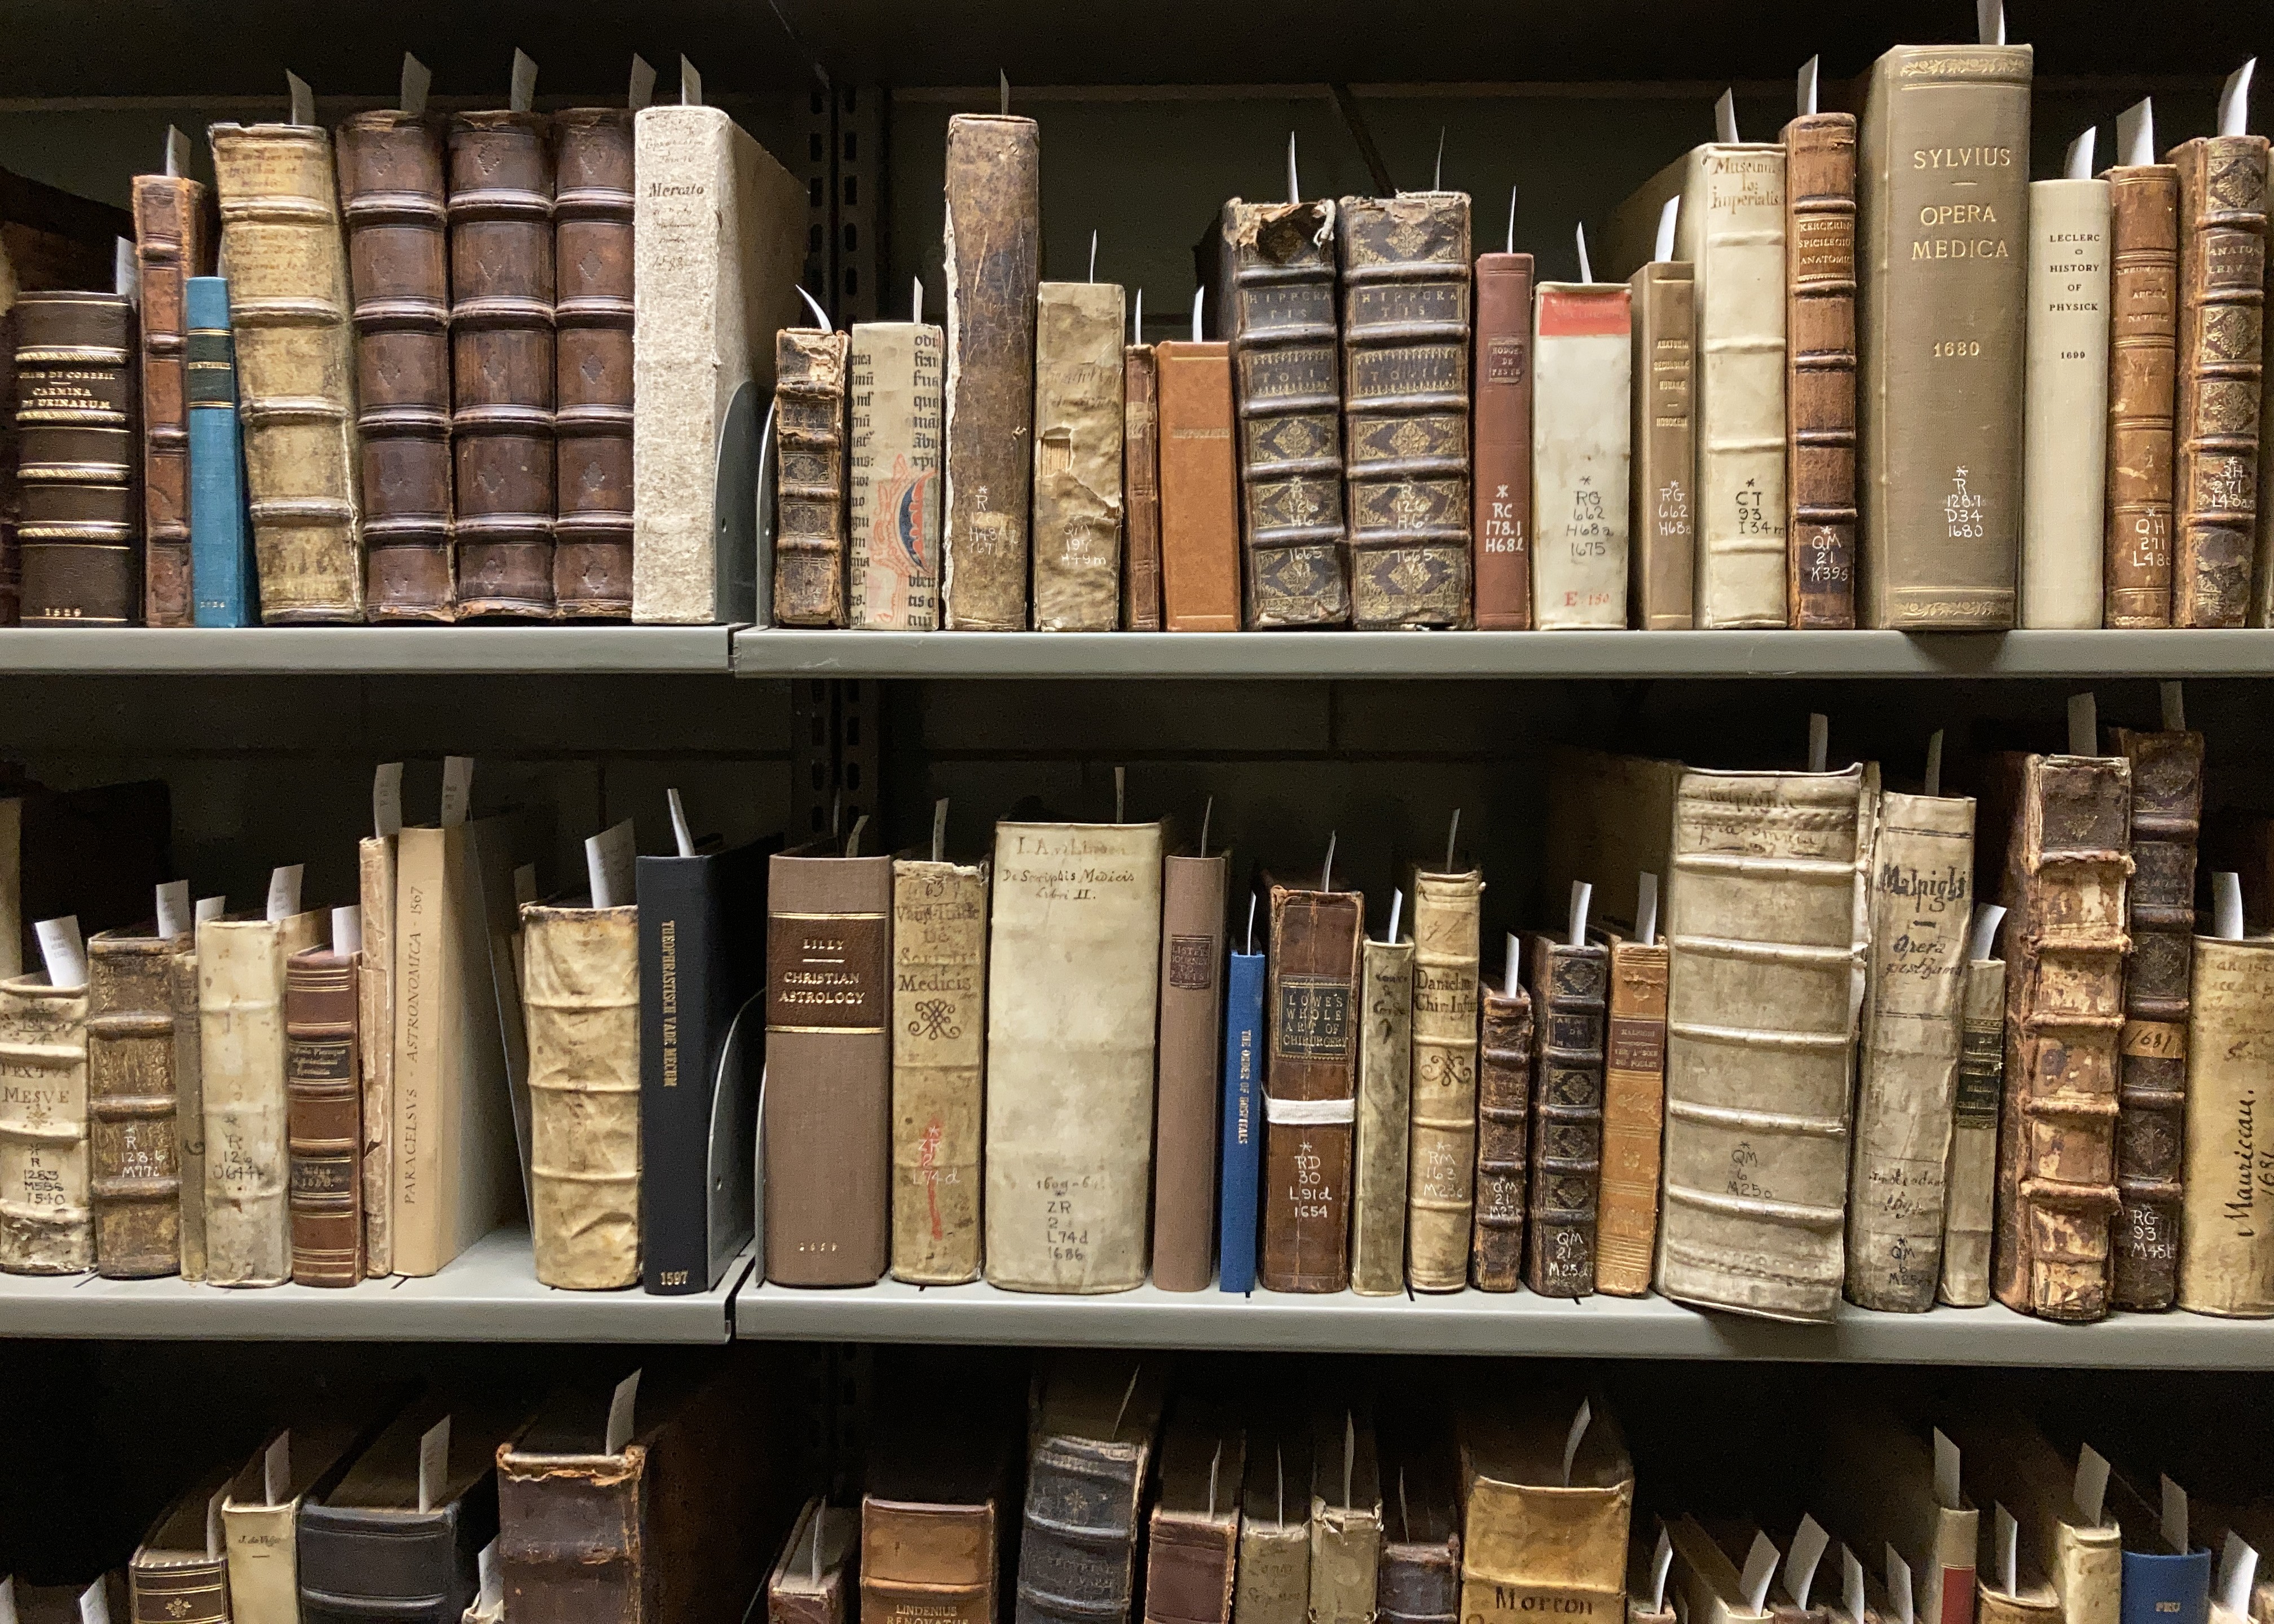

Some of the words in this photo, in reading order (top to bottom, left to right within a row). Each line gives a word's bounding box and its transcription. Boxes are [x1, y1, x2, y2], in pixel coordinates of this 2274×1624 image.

[1913, 147, 2011, 169] SYLVIUS
[1920, 204, 1997, 226] OPERA
[2050, 234, 2100, 243] LECLERC
[1911, 240, 2009, 261] MEDICA
[2050, 264, 2100, 273] HISTORY
[2049, 303, 2099, 312] PHYSICK
[1933, 341, 1980, 358] 1680
[32, 387, 92, 396] CARMINA
[37, 399, 112, 409] URINARUM
[1953, 478, 1967, 495] R
[1573, 491, 1602, 506] RG
[1659, 488, 1685, 502] RG
[975, 495, 988, 511] R
[1492, 502, 1513, 519] RC
[1573, 506, 1606, 522] 662
[1659, 504, 1689, 518] 662
[1738, 508, 1762, 522] 93
[1944, 508, 1983, 523] D34
[1486, 520, 1521, 536] 178.1
[1948, 523, 1983, 538] 1680
[2135, 518, 2165, 535] QH
[1570, 541, 1606, 557] 1675
[1812, 535, 1842, 550] QM
[2140, 536, 2165, 550] 271
[1289, 548, 1323, 562] 1665
[1816, 551, 1834, 565] 21
[1002, 869, 1017, 881] De
[1078, 868, 1135, 884] Medicis
[802, 938, 844, 950] LILLY
[783, 971, 860, 985] CHRISTIAN
[406, 932, 421, 1064] ASTRONOMICA
[778, 990, 865, 1004] ASTROLOGY
[1286, 1008, 1342, 1021] WHOLE
[1325, 1022, 1339, 1034] OF
[124, 1136, 137, 1150] R
[1294, 1154, 1321, 1170] RD
[1427, 1150, 1456, 1165] RM
[1731, 1149, 1758, 1168] QM
[1298, 1170, 1321, 1184] 30
[1426, 1166, 1456, 1180] 163
[1737, 1167, 1747, 1181] 6
[1047, 1201, 1072, 1214] ZR
[1294, 1204, 1328, 1219] 1654
[1048, 1217, 1058, 1229] 2
[2129, 1210, 2159, 1226] RG
[1047, 1231, 1089, 1245] L74d
[1557, 1232, 1584, 1247] QM
[2133, 1225, 2156, 1241] 93
[1556, 1247, 1571, 1259] 21
[1891, 1246, 1916, 1261] QM
[660, 1270, 689, 1286] 1597
[896, 1604, 958, 1617] LINDENIUS
